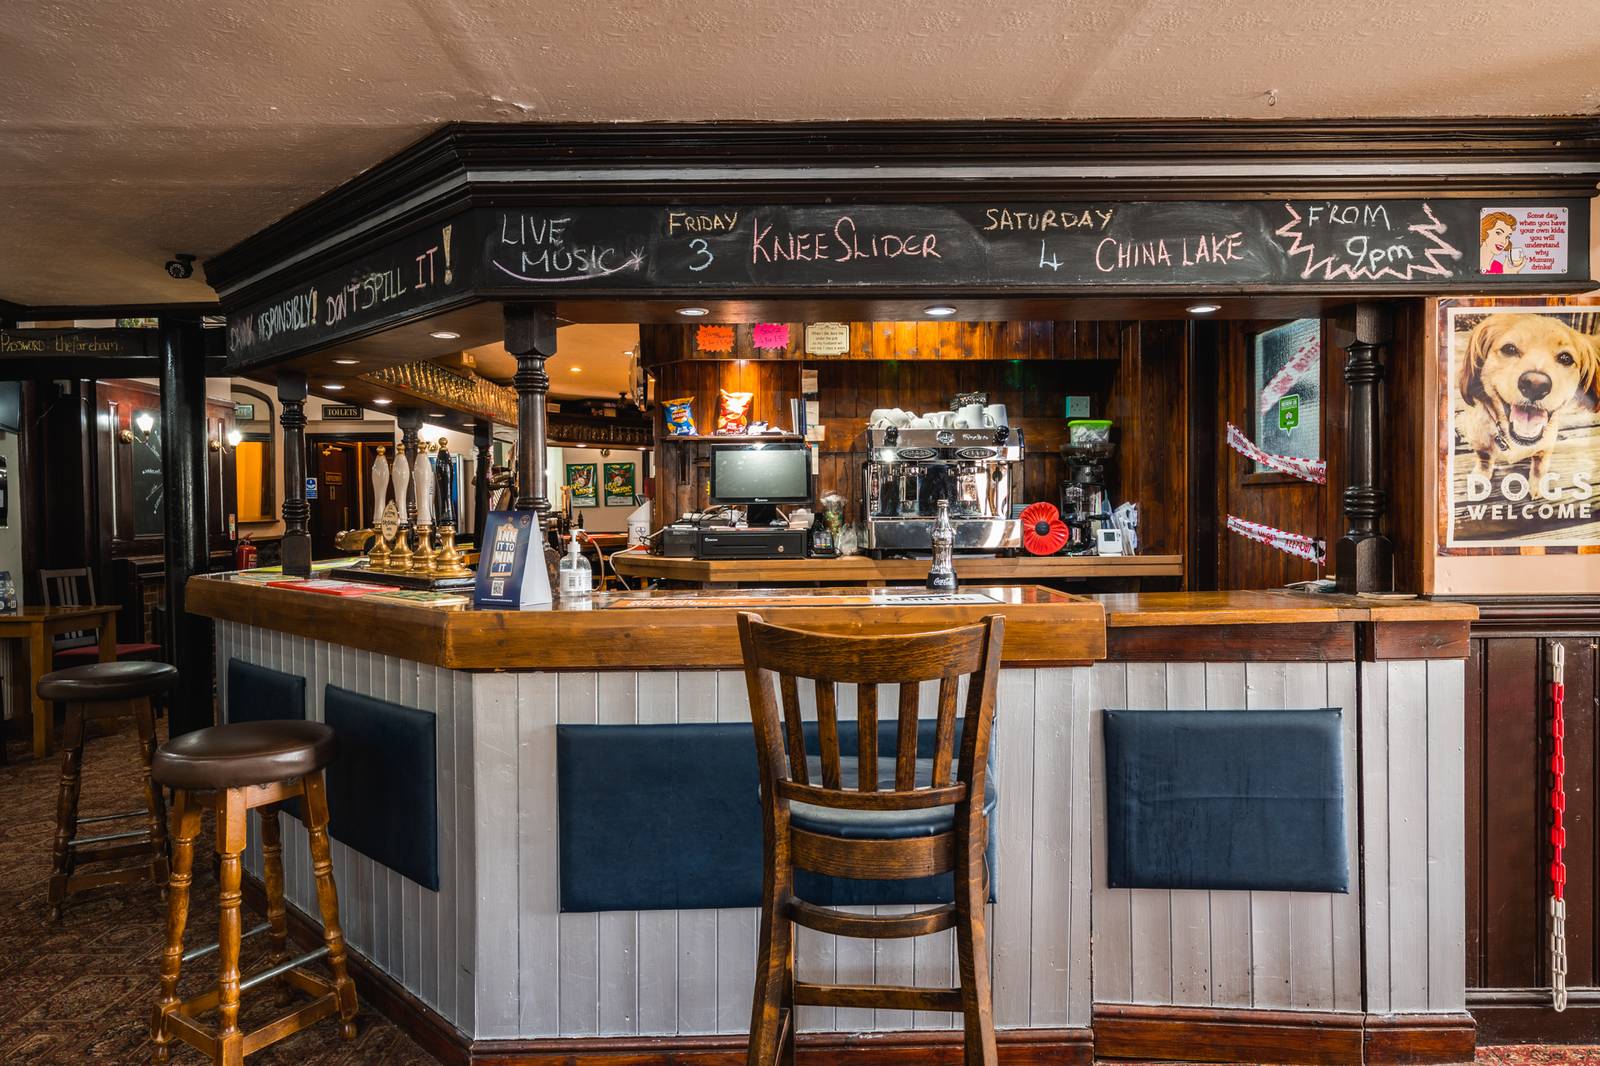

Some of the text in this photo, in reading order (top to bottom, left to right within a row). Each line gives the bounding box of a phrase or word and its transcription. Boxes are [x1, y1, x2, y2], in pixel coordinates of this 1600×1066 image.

[501, 213, 572, 247] LIVE
[668, 211, 738, 236] FRIDAY
[983, 208, 1114, 231] SATURDAY
[1308, 204, 1390, 230] FROM
[521, 247, 616, 273] MUSIC
[688, 238, 714, 271] 3
[1039, 238, 1064, 272] 4
[1096, 232, 1244, 273] CHINA LAKE
[1346, 235, 1414, 272] 9pm
[1535, 249, 1549, 257] why
[362, 267, 406, 310] SPILL
[328, 409, 358, 417] TOILETS
[1466, 471, 1593, 501] DOGS
[1467, 503, 1592, 521] WELCOME
[496, 542, 515, 551] IT TO
[498, 563, 506, 572] IT
